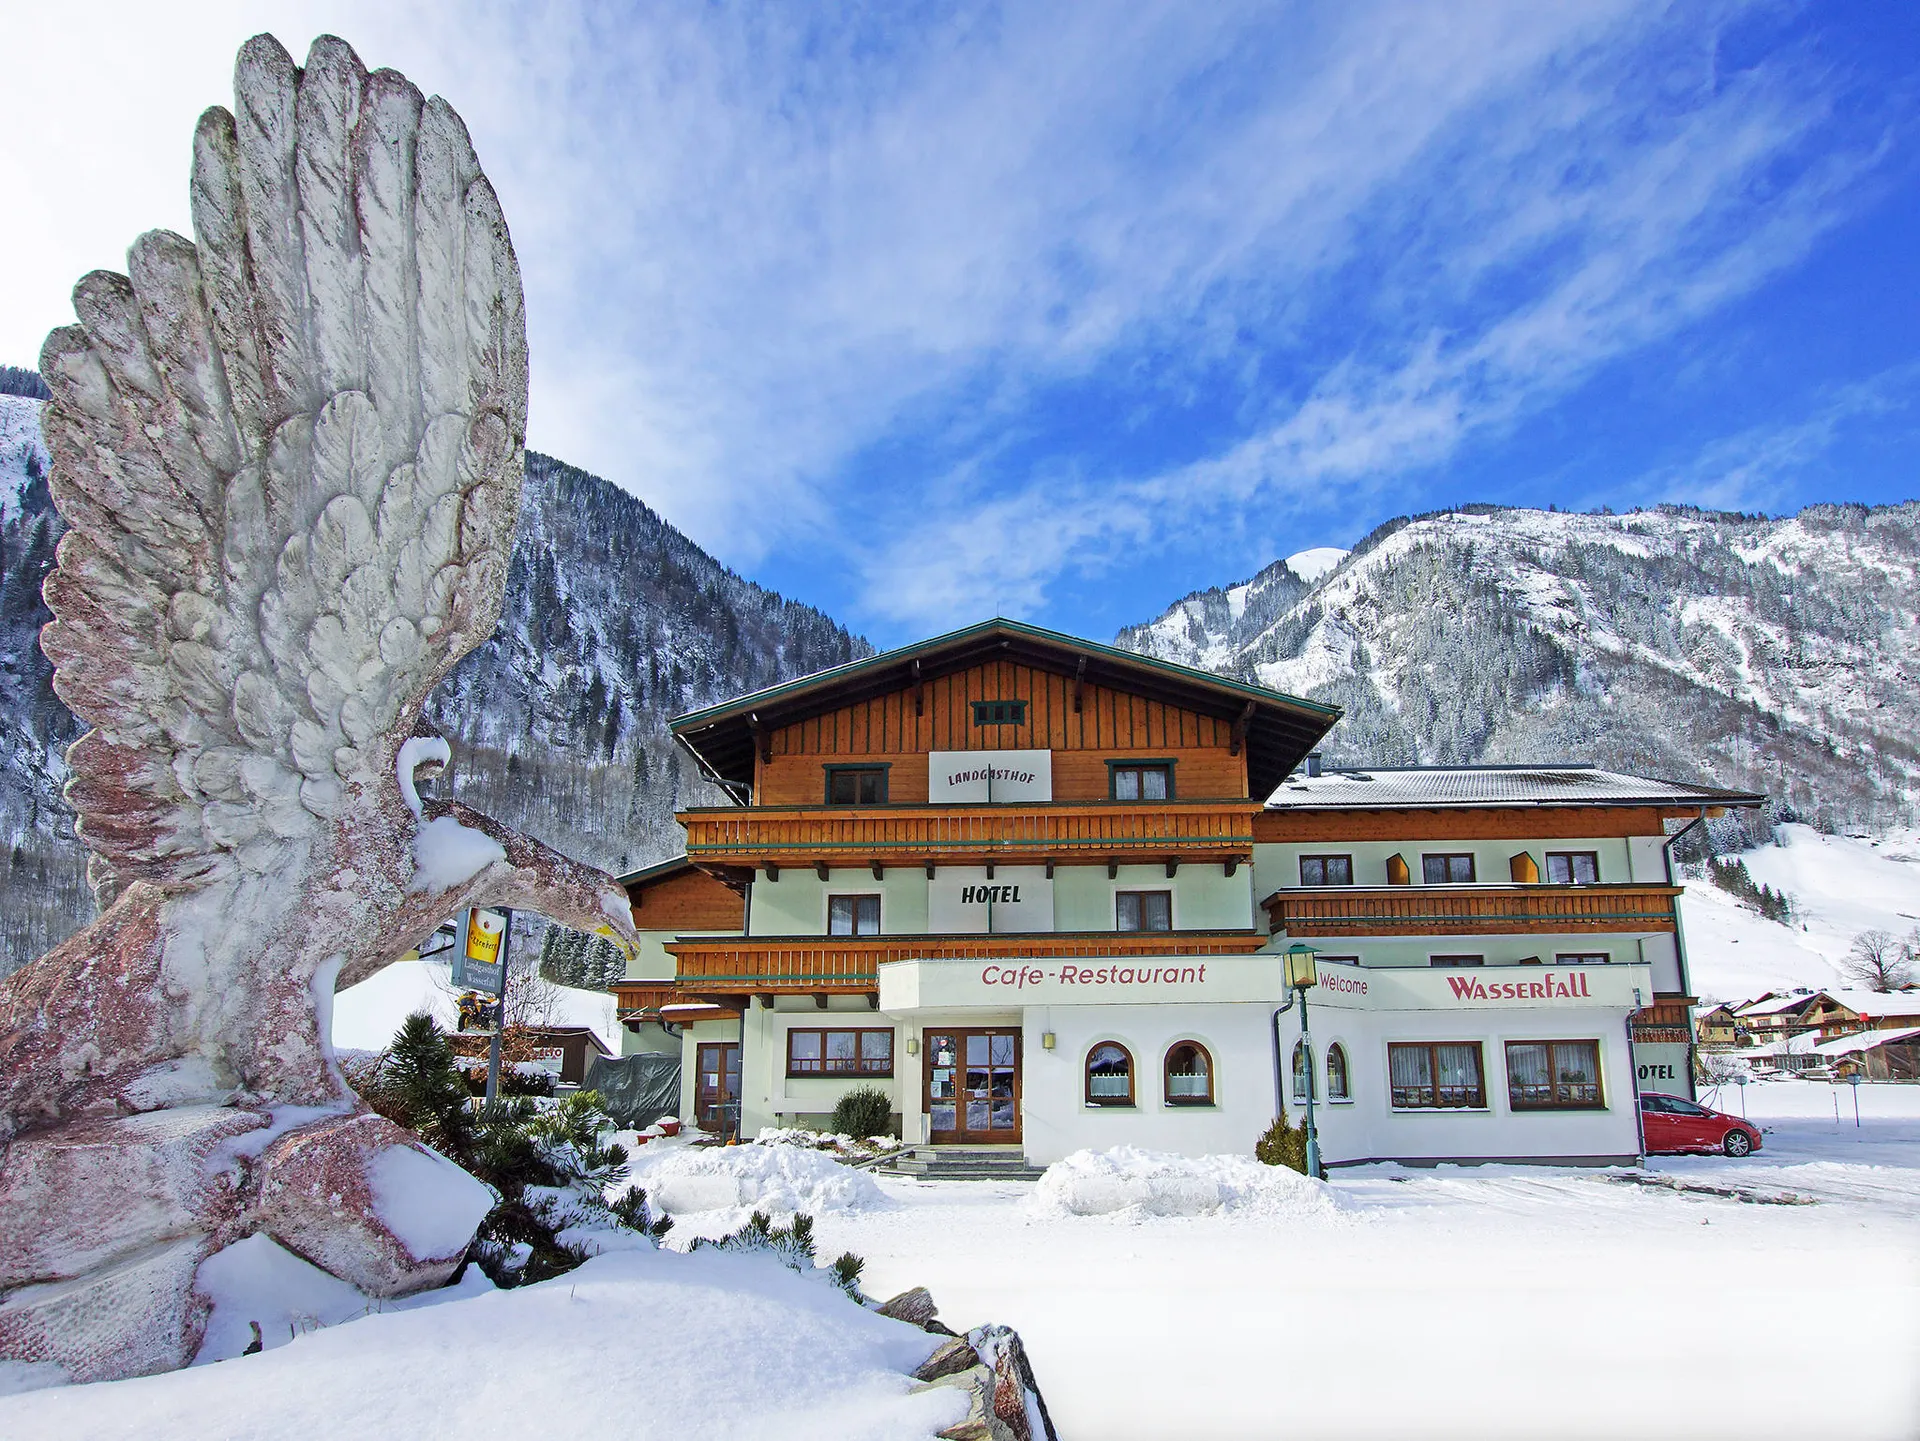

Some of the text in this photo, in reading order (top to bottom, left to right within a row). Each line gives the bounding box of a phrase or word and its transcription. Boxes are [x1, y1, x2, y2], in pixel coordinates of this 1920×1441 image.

[948, 769, 1036, 786] LANDGASTHOF
[961, 885, 1021, 904] HOTEL
[1319, 972, 1368, 995] Welcome
[1638, 1064, 1675, 1080] OTEL
